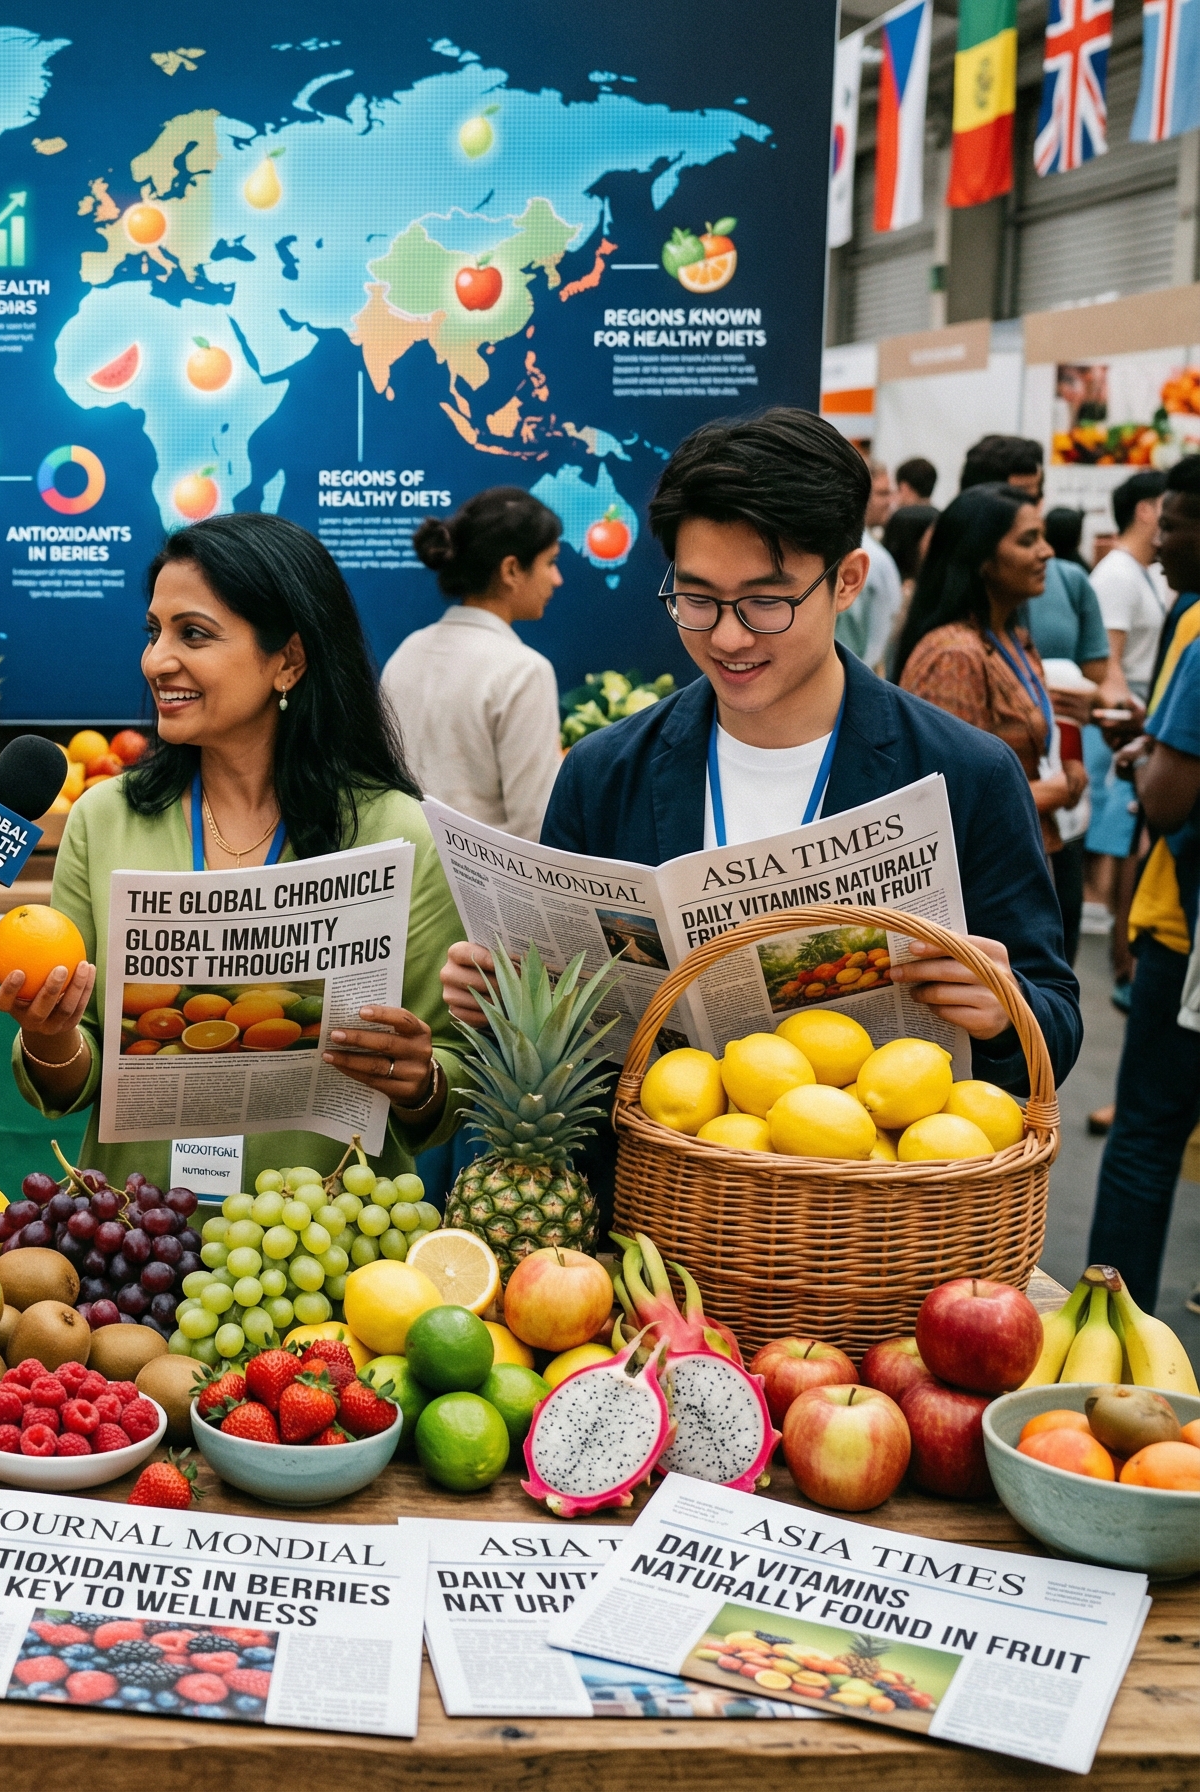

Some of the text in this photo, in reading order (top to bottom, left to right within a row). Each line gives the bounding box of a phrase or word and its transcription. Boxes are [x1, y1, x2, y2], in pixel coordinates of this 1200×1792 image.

[604, 308, 761, 326] REGIONS KNOWN
[594, 329, 767, 347] FOR HEALTHY DIETS
[318, 470, 425, 487] REGIONS OF
[318, 490, 452, 507] HEALTHY DIETS
[6, 526, 132, 542] ANTIOXIDANTS
[28, 545, 110, 562] IN BERIES
[445, 828, 533, 879] JOURNAL
[535, 866, 645, 904] MONDIAL
[701, 813, 904, 891] ASIA TIMES
[127, 865, 396, 915] THE GLOBAL CHRONICLE
[681, 841, 939, 929] DAILY VITAMINS NATURALLY
[857, 888, 877, 906] IN
[880, 867, 933, 903] FRUIT
[125, 916, 339, 952] GLOBAL IMMUNITY
[124, 935, 392, 978] BOOST THROUGH CITRUS
[184, 1528, 386, 1567] MONDIAL
[479, 1537, 592, 1557] ASIA
[741, 1518, 852, 1561] ASIA
[872, 1545, 1026, 1596] TIMES
[202, 1569, 238, 1591] IN
[245, 1573, 392, 1606] BERRIES
[437, 1570, 525, 1589] DAILY
[535, 1572, 598, 1590] VIT
[655, 1533, 910, 1609] DAILY VITAMINS
[3, 1576, 319, 1627] KEY TO WELLNESS
[630, 1553, 817, 1613] NATURALLY
[819, 1598, 933, 1640] FOUND
[940, 1625, 978, 1650] IN
[985, 1635, 1091, 1675] FRUIT
